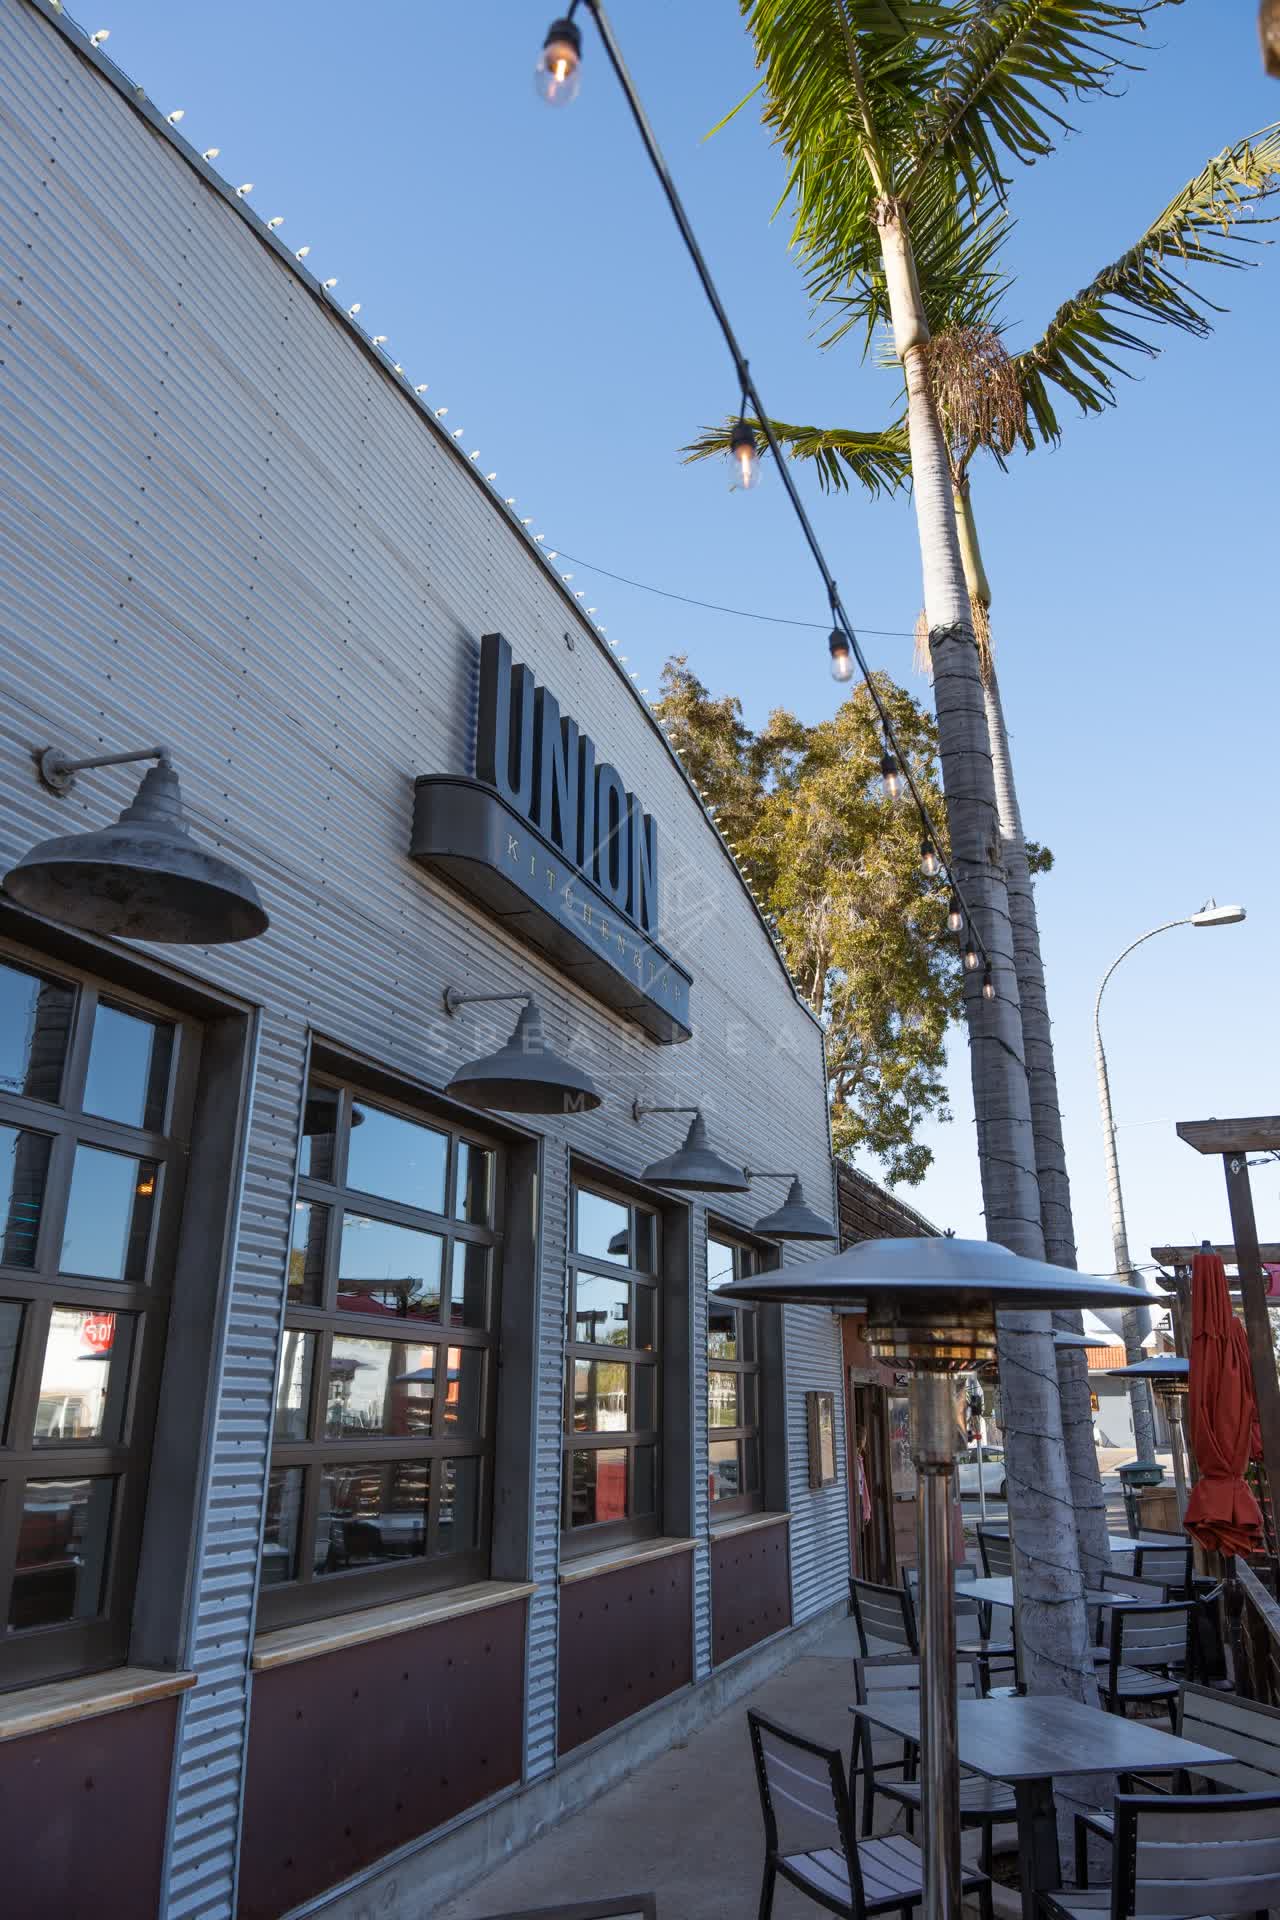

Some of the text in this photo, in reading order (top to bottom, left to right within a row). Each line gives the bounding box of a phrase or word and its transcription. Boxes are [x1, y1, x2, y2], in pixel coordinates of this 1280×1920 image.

[478, 632, 658, 938] UNION
[507, 834, 682, 1001] KITCHEN & TAP
